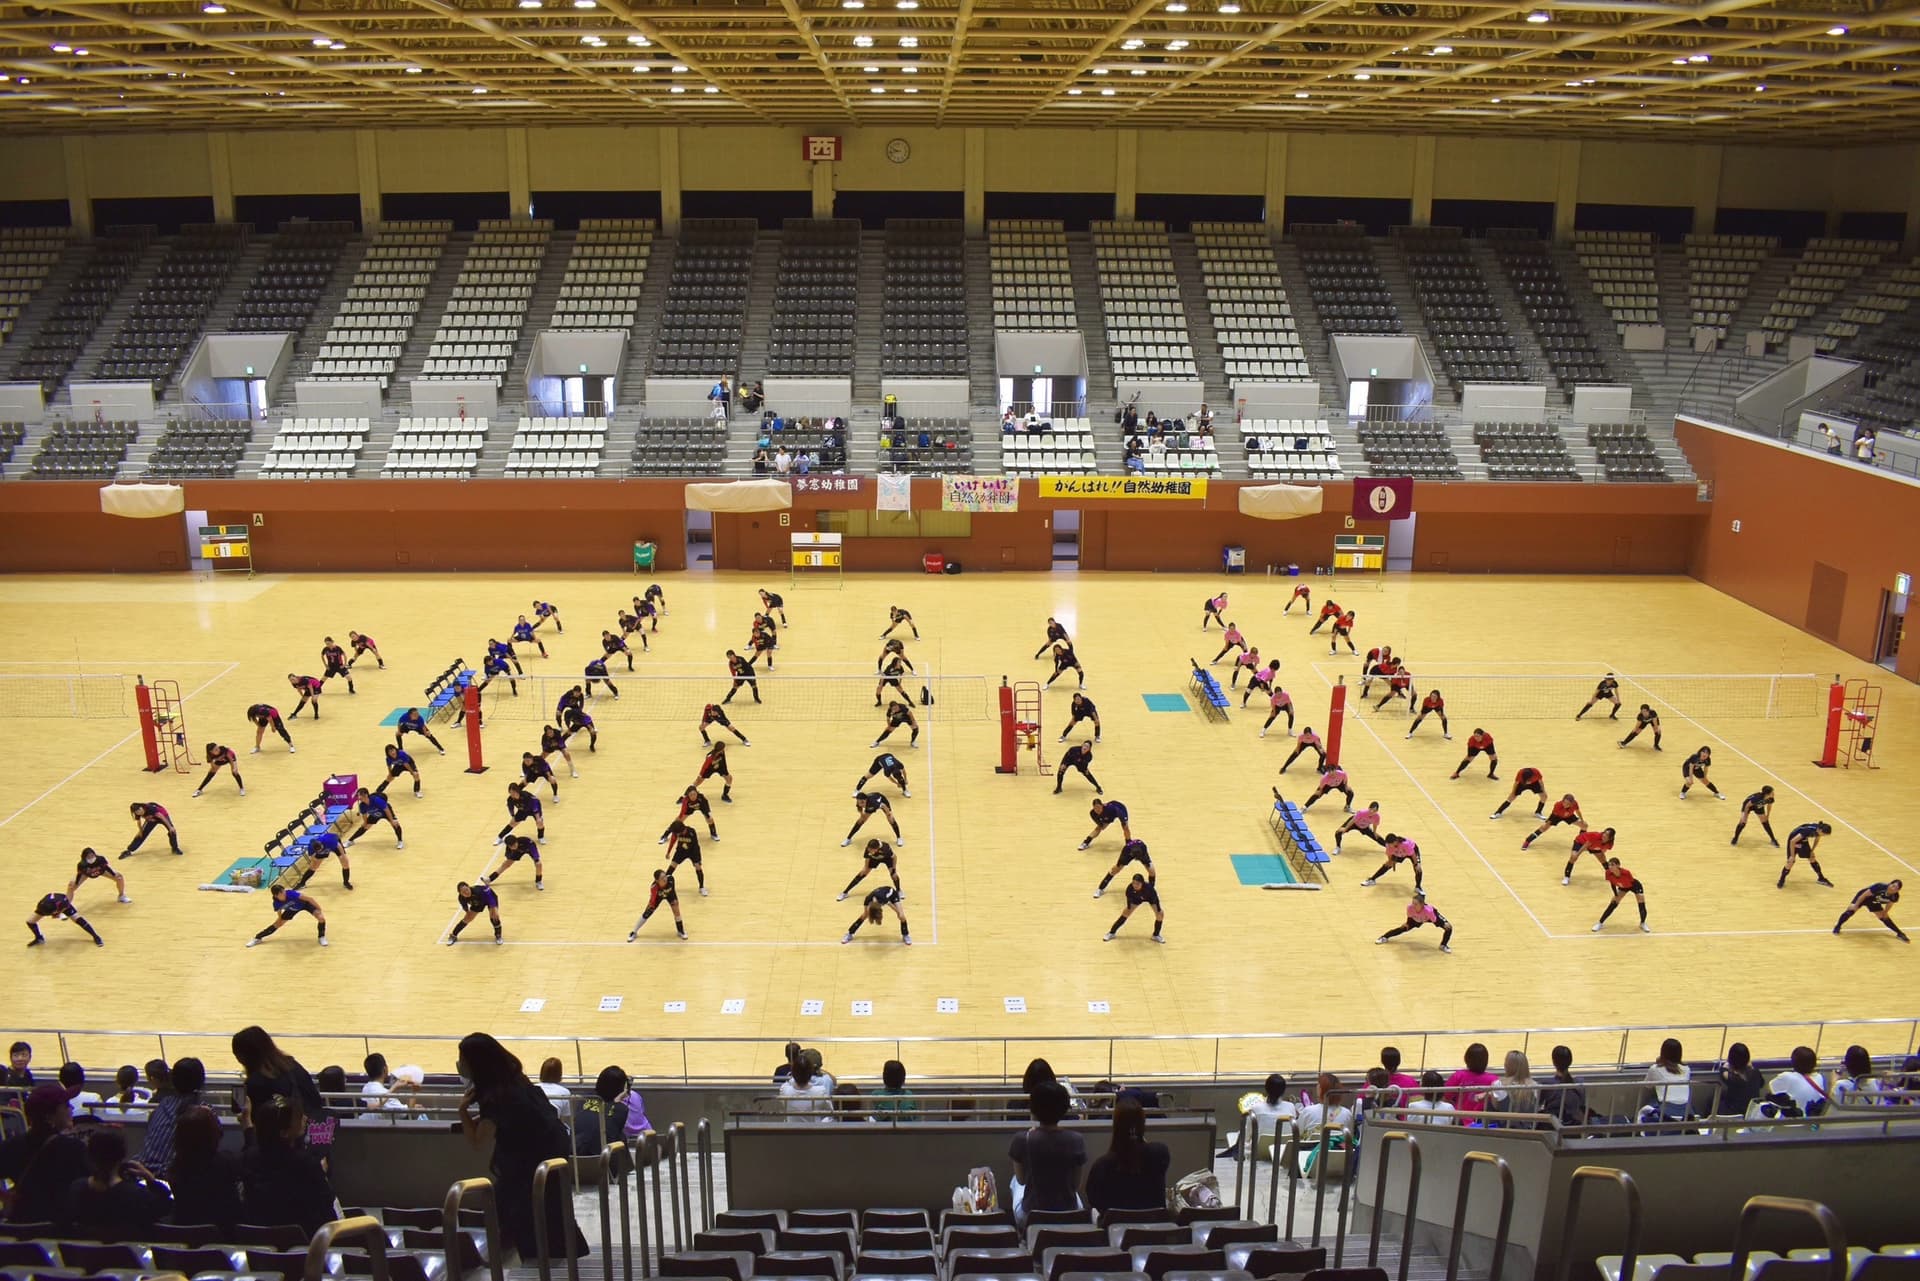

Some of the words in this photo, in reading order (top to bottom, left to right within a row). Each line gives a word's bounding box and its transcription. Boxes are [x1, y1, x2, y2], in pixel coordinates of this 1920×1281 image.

[808, 137, 835, 160] 西
[254, 514, 262, 525] A
[781, 514, 790, 525] B
